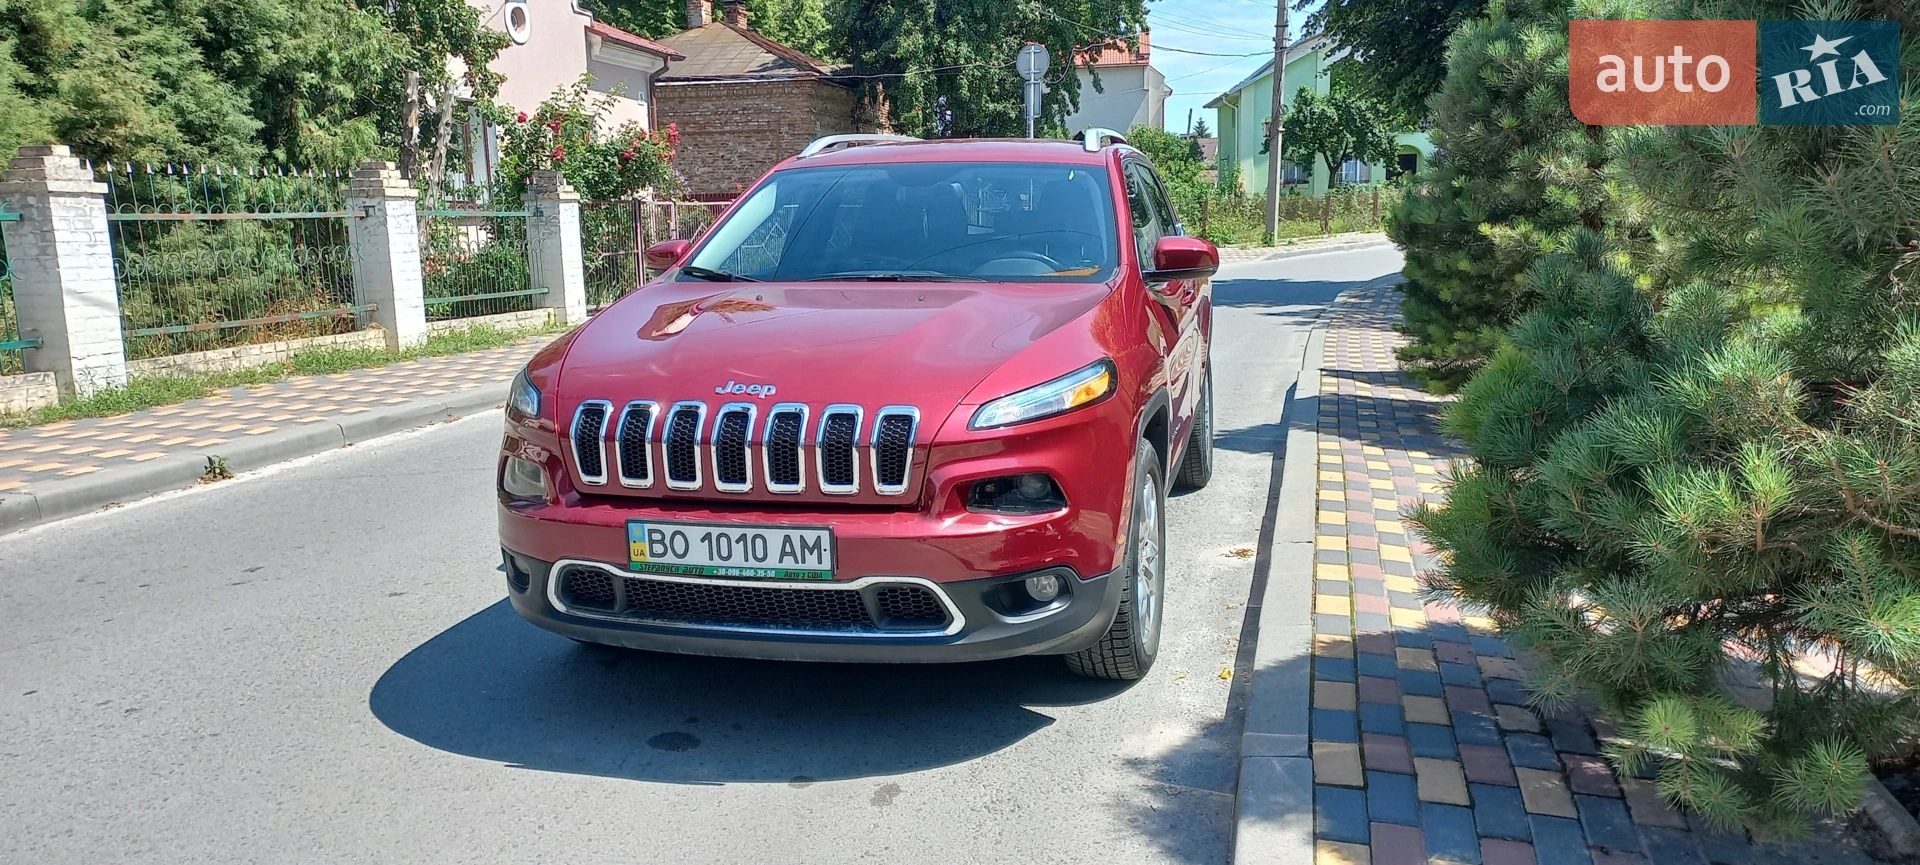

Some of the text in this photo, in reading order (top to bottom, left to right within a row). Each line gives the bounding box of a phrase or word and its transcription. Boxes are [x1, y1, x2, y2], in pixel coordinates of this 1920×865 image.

[715, 380, 776, 399] Jeep
[633, 548, 646, 558] UA
[647, 528, 822, 565] BO 1010 AM
